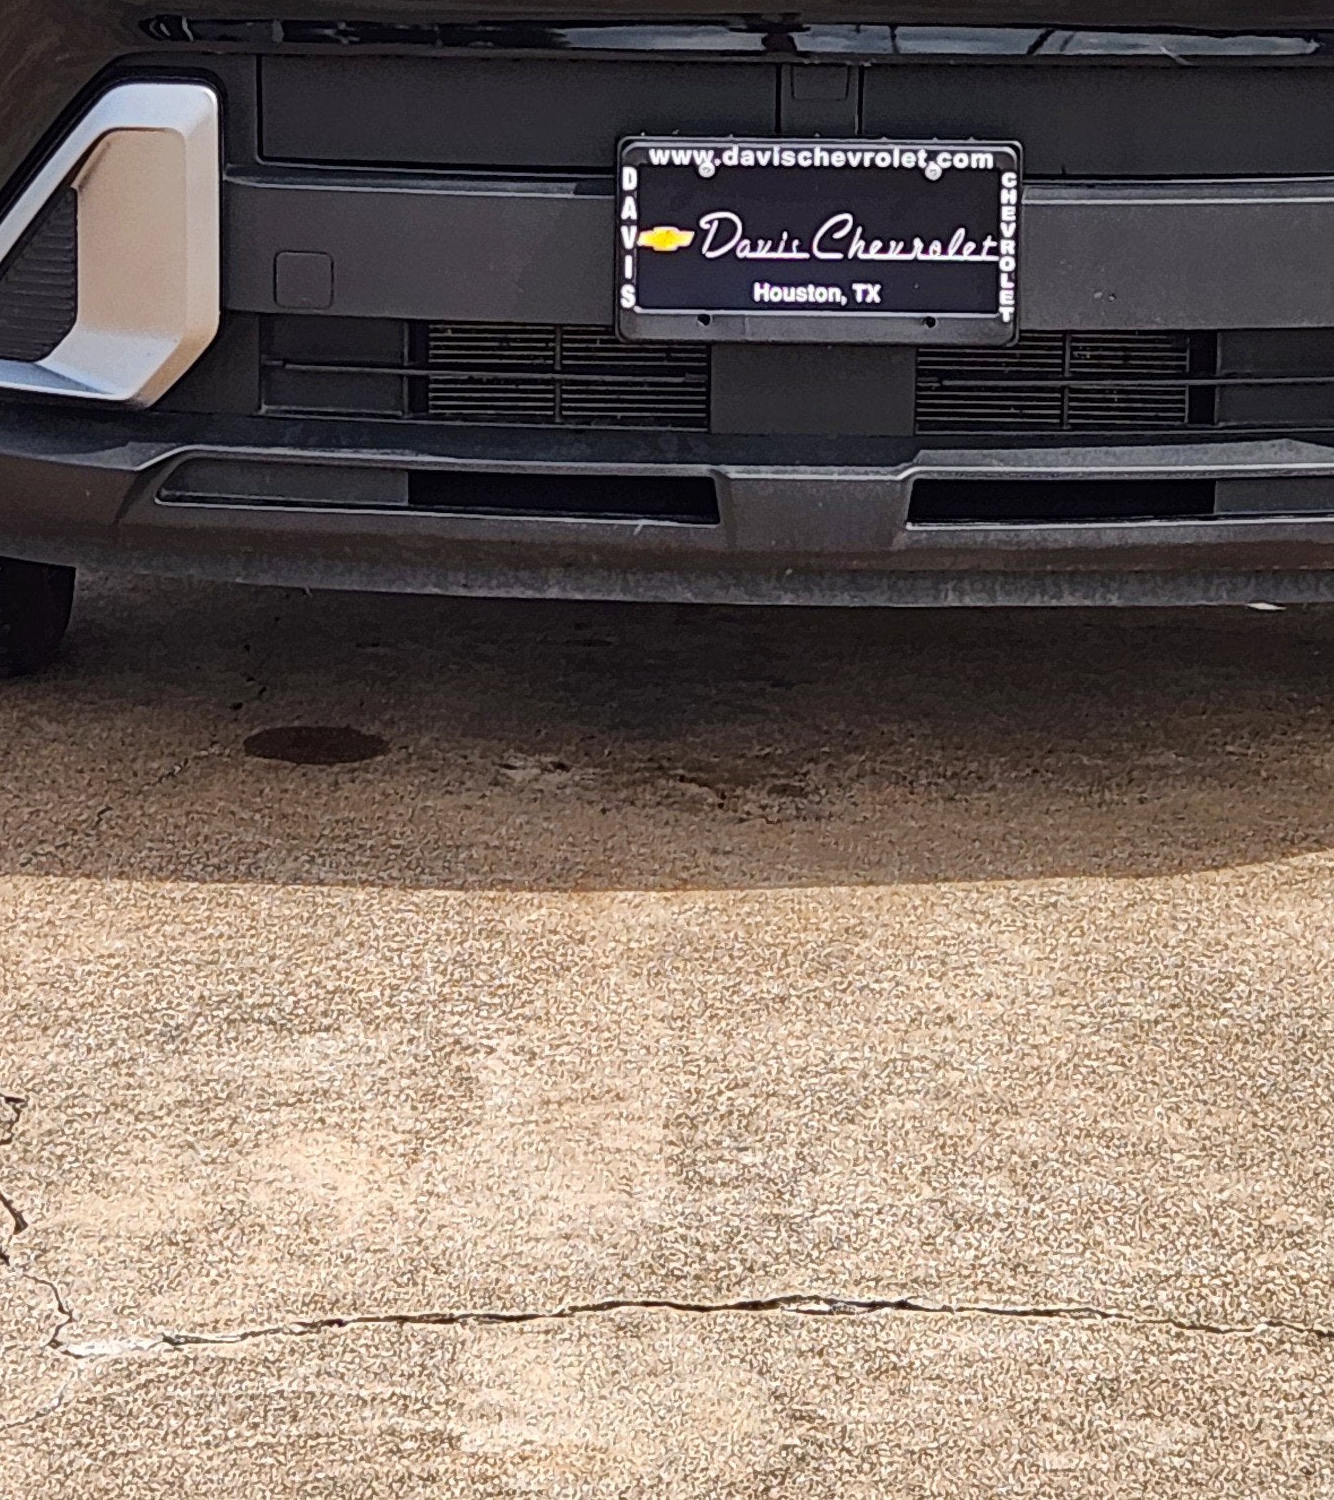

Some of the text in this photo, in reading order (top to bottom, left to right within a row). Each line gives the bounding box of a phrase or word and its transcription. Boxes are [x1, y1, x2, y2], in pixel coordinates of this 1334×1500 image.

[621, 166, 638, 309] DAVIS
[699, 211, 999, 262] Davis Chevrolet
[998, 172, 1018, 323] CHEVROLET
[753, 282, 882, 306] Houston, TX
